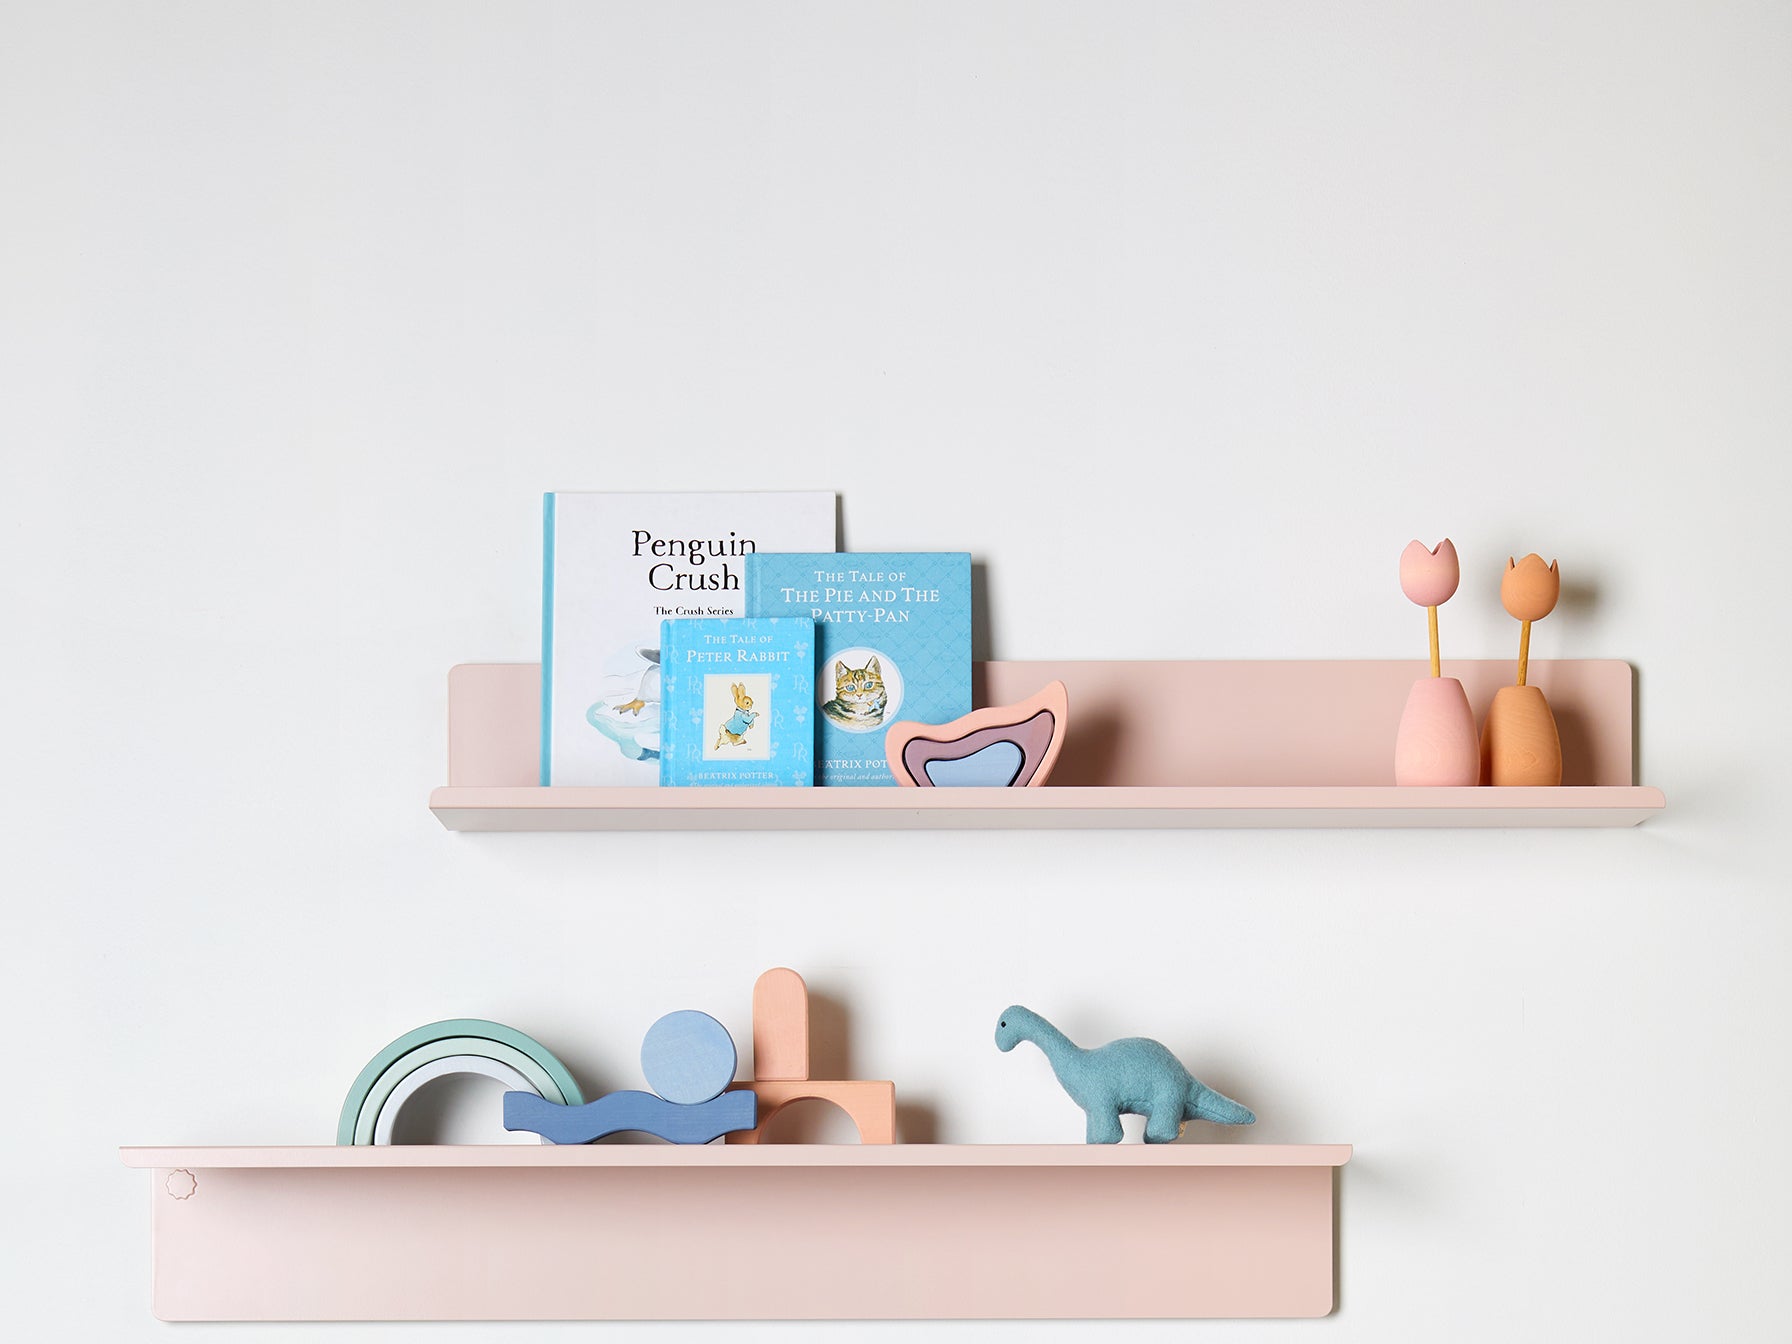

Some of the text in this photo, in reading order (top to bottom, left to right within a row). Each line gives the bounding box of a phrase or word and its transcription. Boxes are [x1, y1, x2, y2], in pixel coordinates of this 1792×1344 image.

[632, 530, 756, 565] Penguin
[649, 563, 740, 591] Crush
[814, 570, 906, 582] THE TALE OF
[781, 587, 940, 603] THE PIE AND THE
[654, 606, 734, 615] The Crush Series
[811, 607, 910, 623] PATTY-PAN
[704, 634, 773, 644] THE TALE OF
[687, 649, 790, 663] PETER RABBIT
[815, 759, 888, 769] EATRIX POT
[698, 771, 773, 780] BEATRIX POTTER
